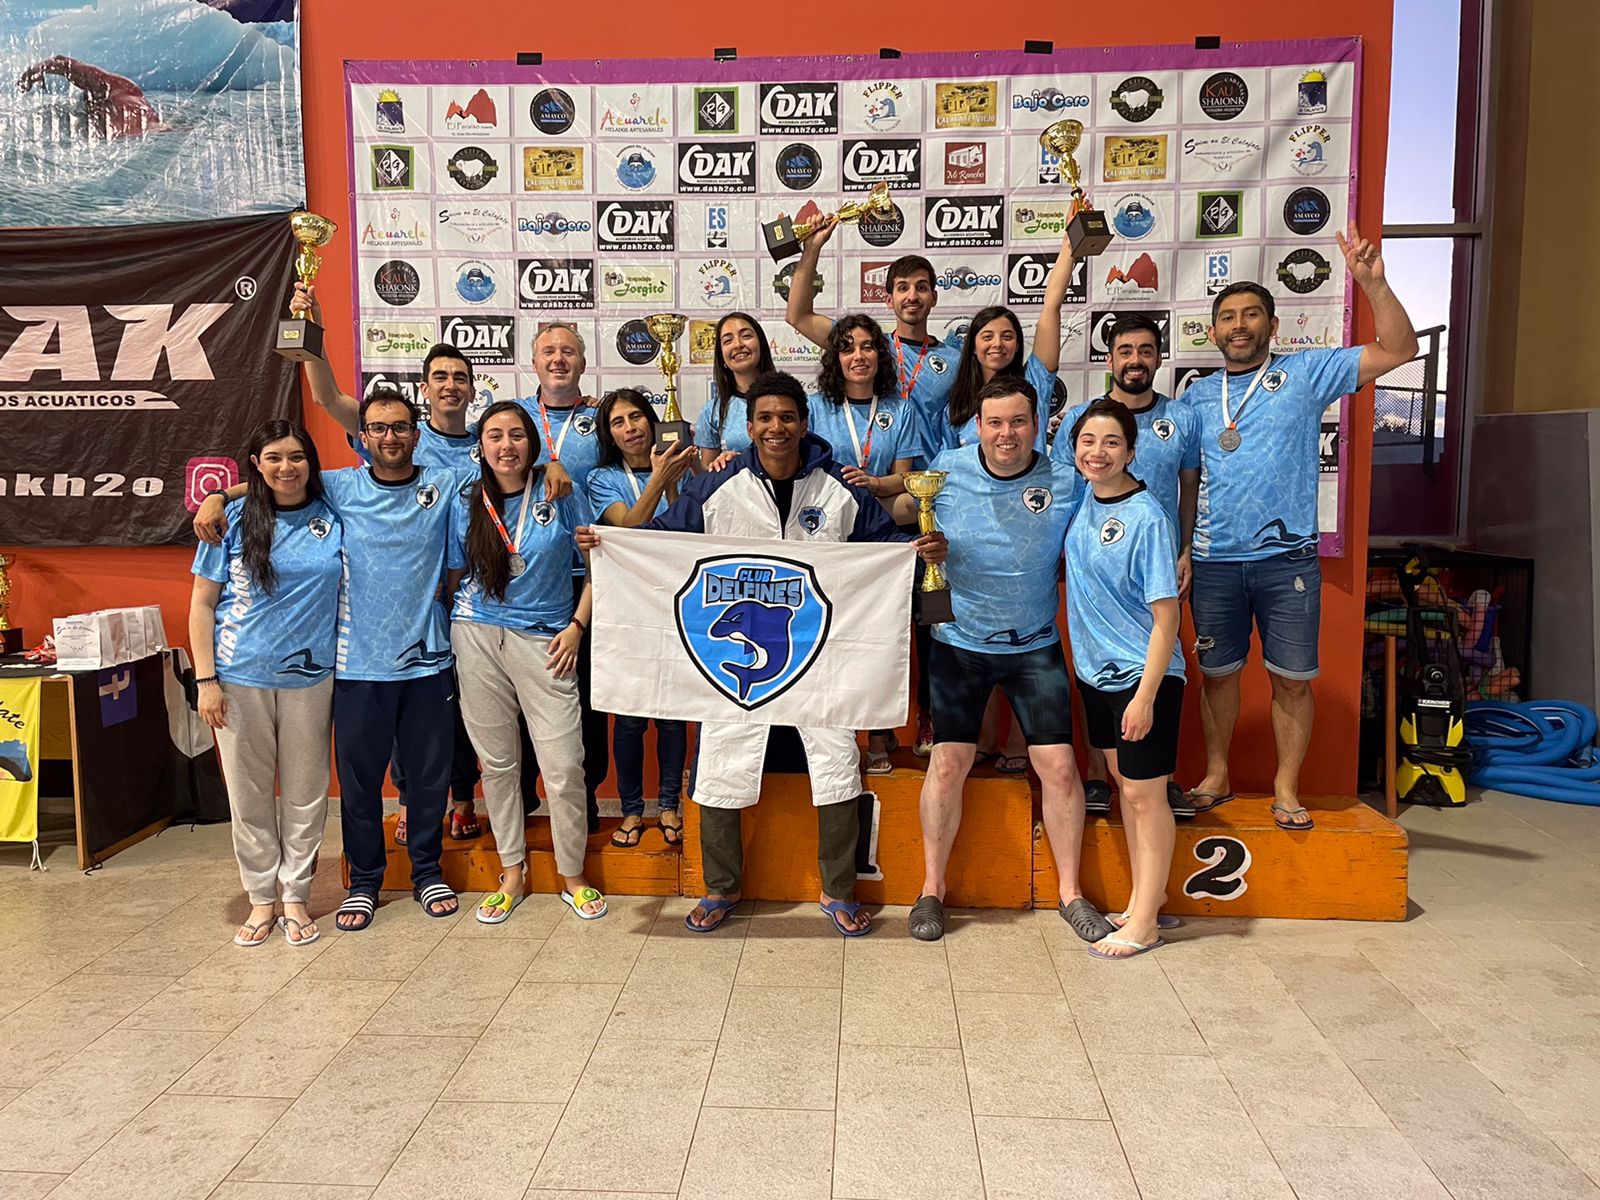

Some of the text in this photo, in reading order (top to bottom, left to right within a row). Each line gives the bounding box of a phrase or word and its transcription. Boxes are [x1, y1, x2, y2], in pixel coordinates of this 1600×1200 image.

[862, 82, 903, 99] FLIPPER
[1206, 81, 1233, 97] KAU
[1013, 89, 1090, 112] Bajo Cero
[1202, 97, 1245, 106] SHAIONK
[761, 126, 837, 134] www.dakh2o.com
[1289, 125, 1331, 143] FLIPPER
[960, 168, 984, 180] Rancho
[518, 213, 591, 234] Bajo Cero
[709, 207, 727, 229] ES
[860, 224, 901, 232] SHAIONK
[1024, 219, 1066, 234] Jorgi
[926, 239, 1002, 247] www.dakh2o.com
[698, 260, 737, 277] FLIPPER
[1209, 255, 1228, 278] ES
[936, 268, 1001, 290] ajo Cero
[376, 284, 417, 292] SHAIONK
[614, 282, 664, 297] Jorgito
[521, 301, 594, 309] www.dakh2o.com
[377, 340, 427, 353] Jorgito
[770, 337, 824, 355] Acuare
[473, 374, 500, 390] IPPER
[25, 395, 136, 407] ACUATICOS
[738, 568, 773, 582] CLUB
[706, 573, 802, 607] DELFINES
[1184, 836, 1250, 900] 2
